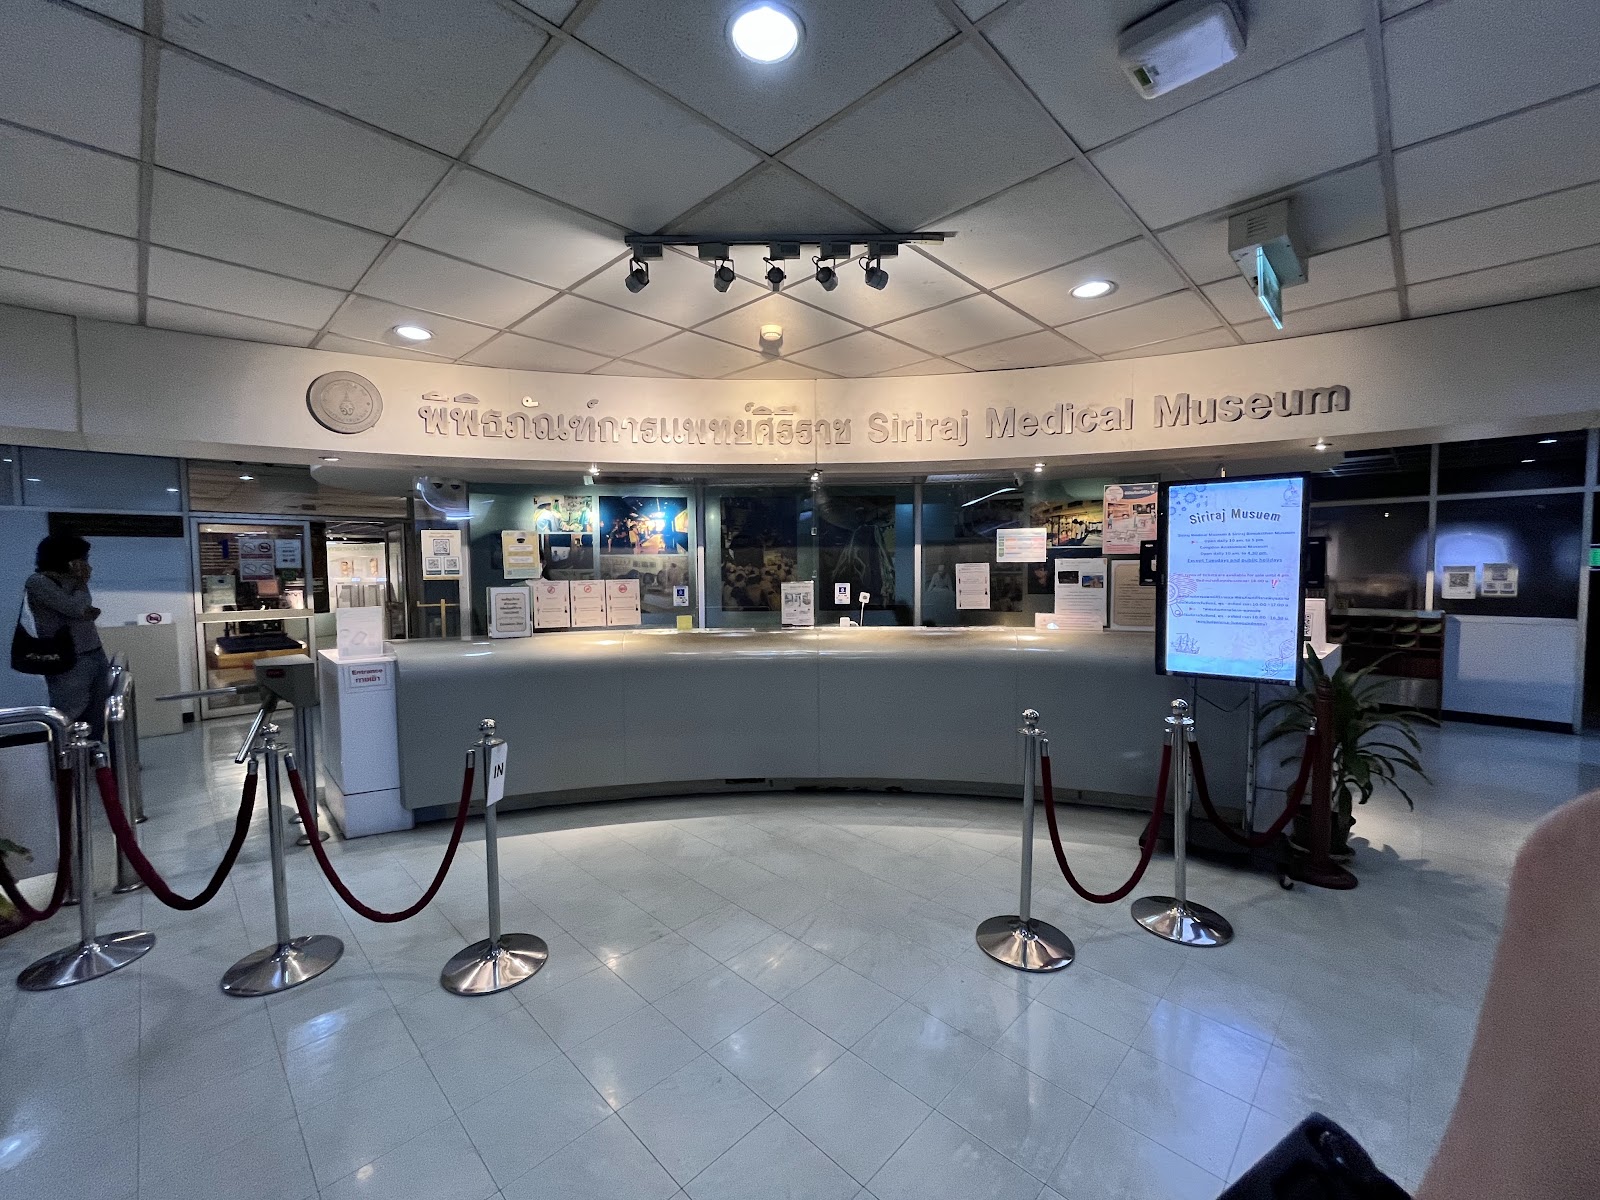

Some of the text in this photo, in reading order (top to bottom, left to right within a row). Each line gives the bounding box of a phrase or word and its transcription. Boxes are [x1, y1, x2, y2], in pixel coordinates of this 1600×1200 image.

[418, 391, 851, 446] พิพิธภัณฑ์การแพทย์ศิริราช
[868, 383, 1351, 447] Siriraj Medical Museum
[1189, 508, 1281, 525] Siriraj Musuem
[493, 762, 504, 779] IN
